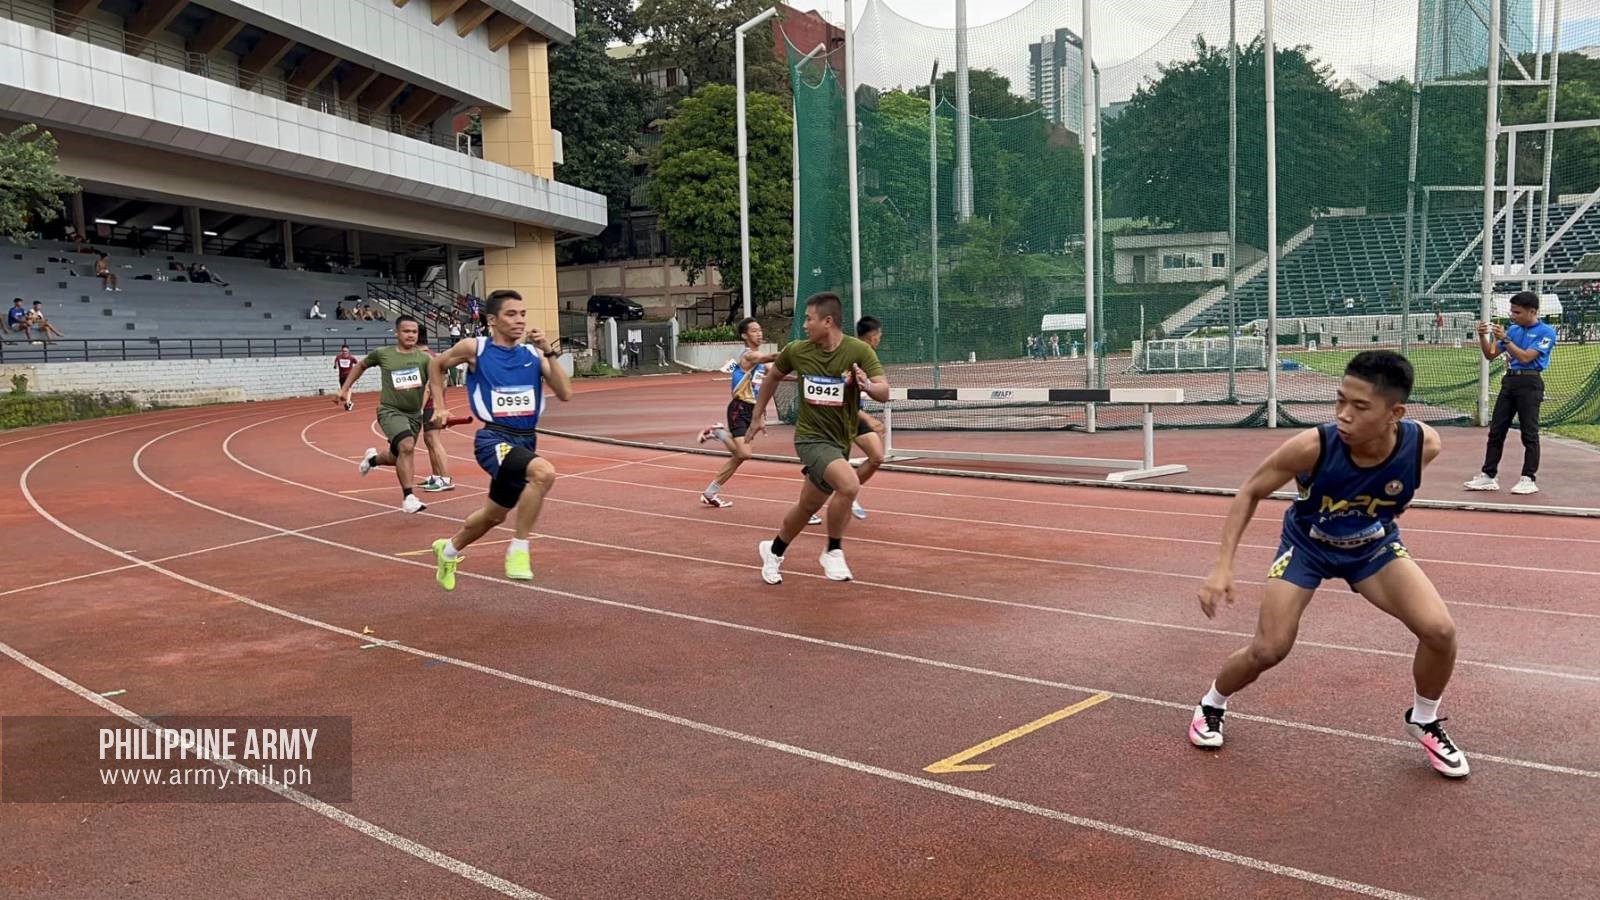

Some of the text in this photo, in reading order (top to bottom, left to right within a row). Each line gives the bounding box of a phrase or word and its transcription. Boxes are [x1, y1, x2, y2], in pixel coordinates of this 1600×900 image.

[395, 374, 418, 384] 0940
[807, 385, 840, 396] 0942
[496, 395, 531, 407] 0999
